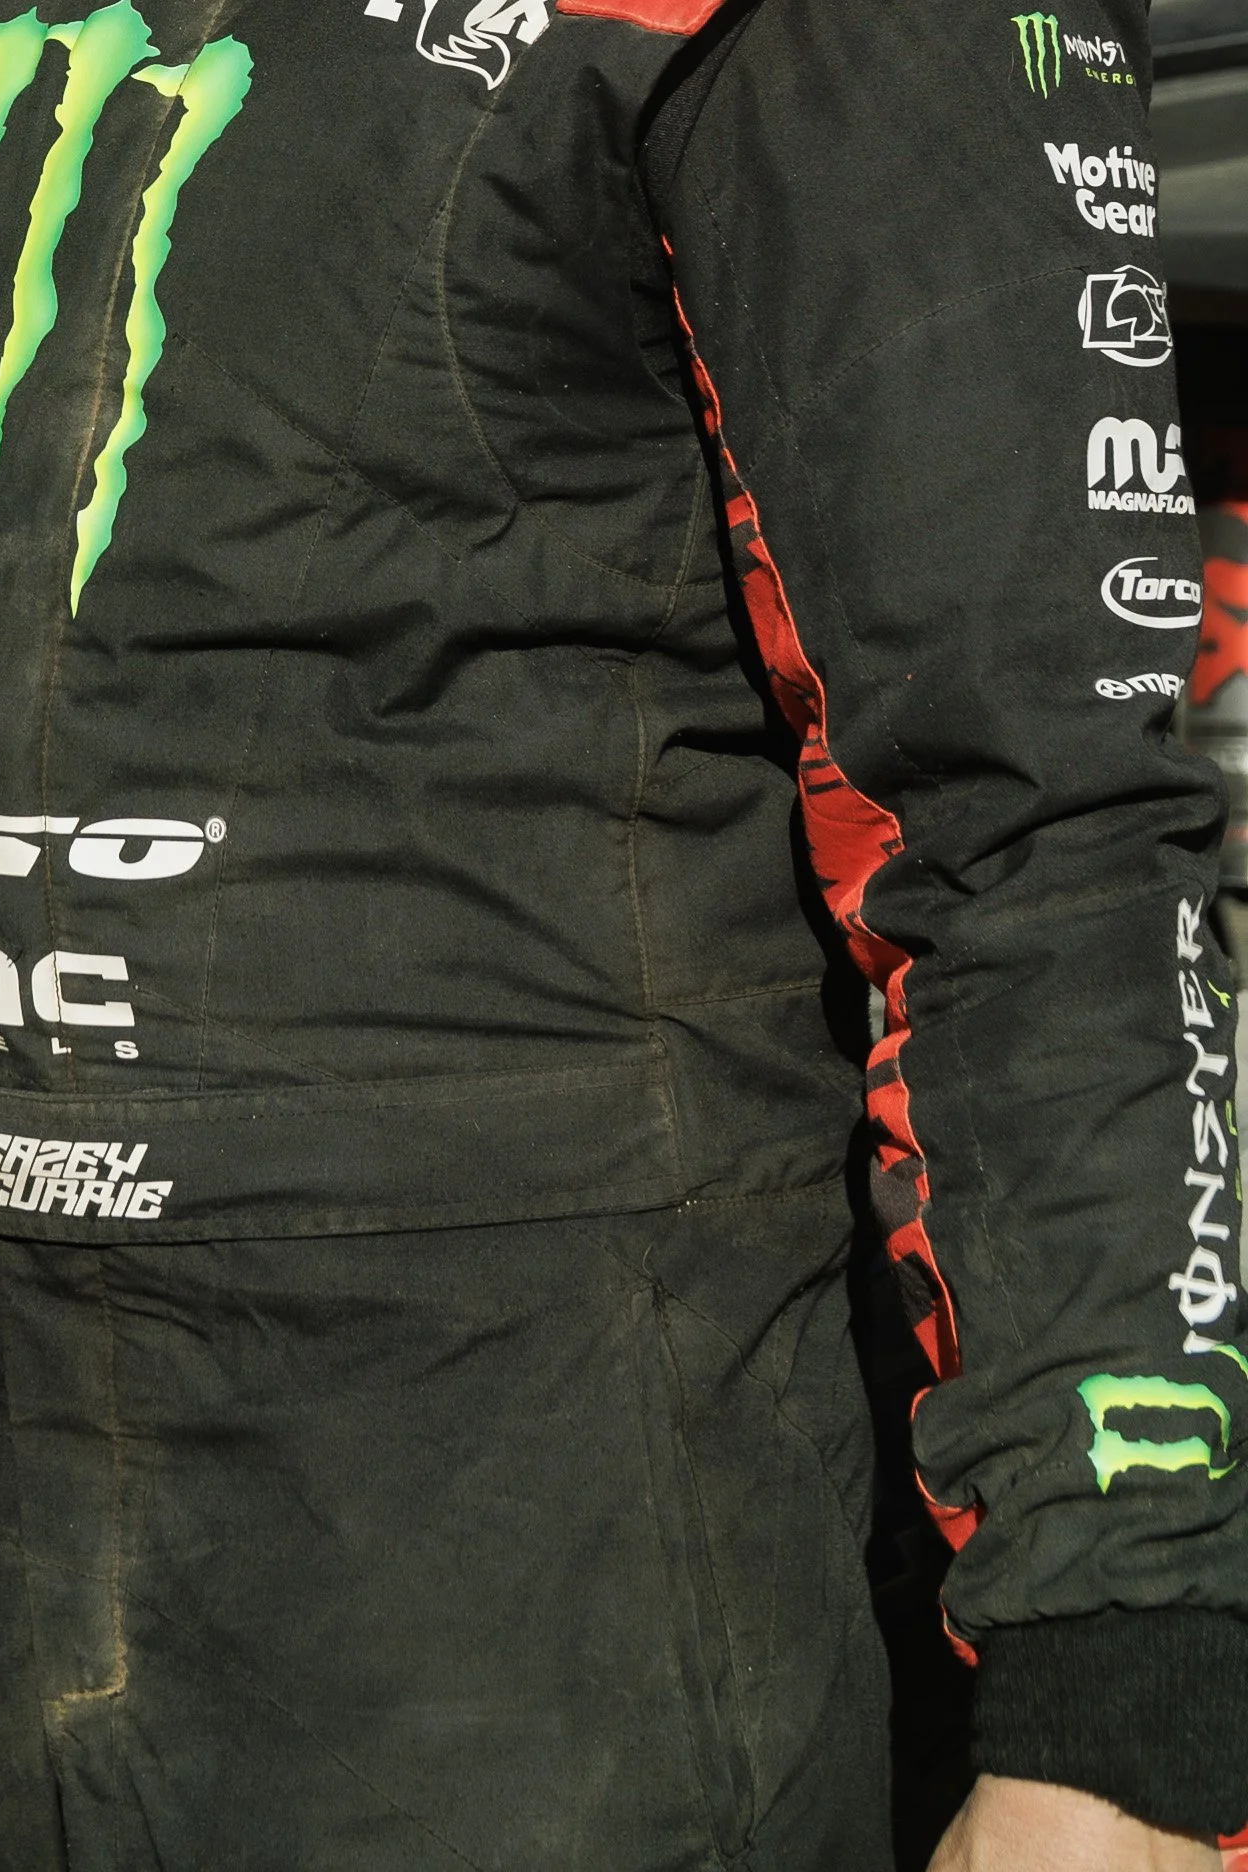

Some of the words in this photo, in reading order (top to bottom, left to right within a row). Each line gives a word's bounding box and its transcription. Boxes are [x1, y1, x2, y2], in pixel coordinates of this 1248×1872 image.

[1085, 67, 1137, 87] ENERG
[1044, 142, 1156, 197] Motive
[1075, 188, 1156, 238] Gear
